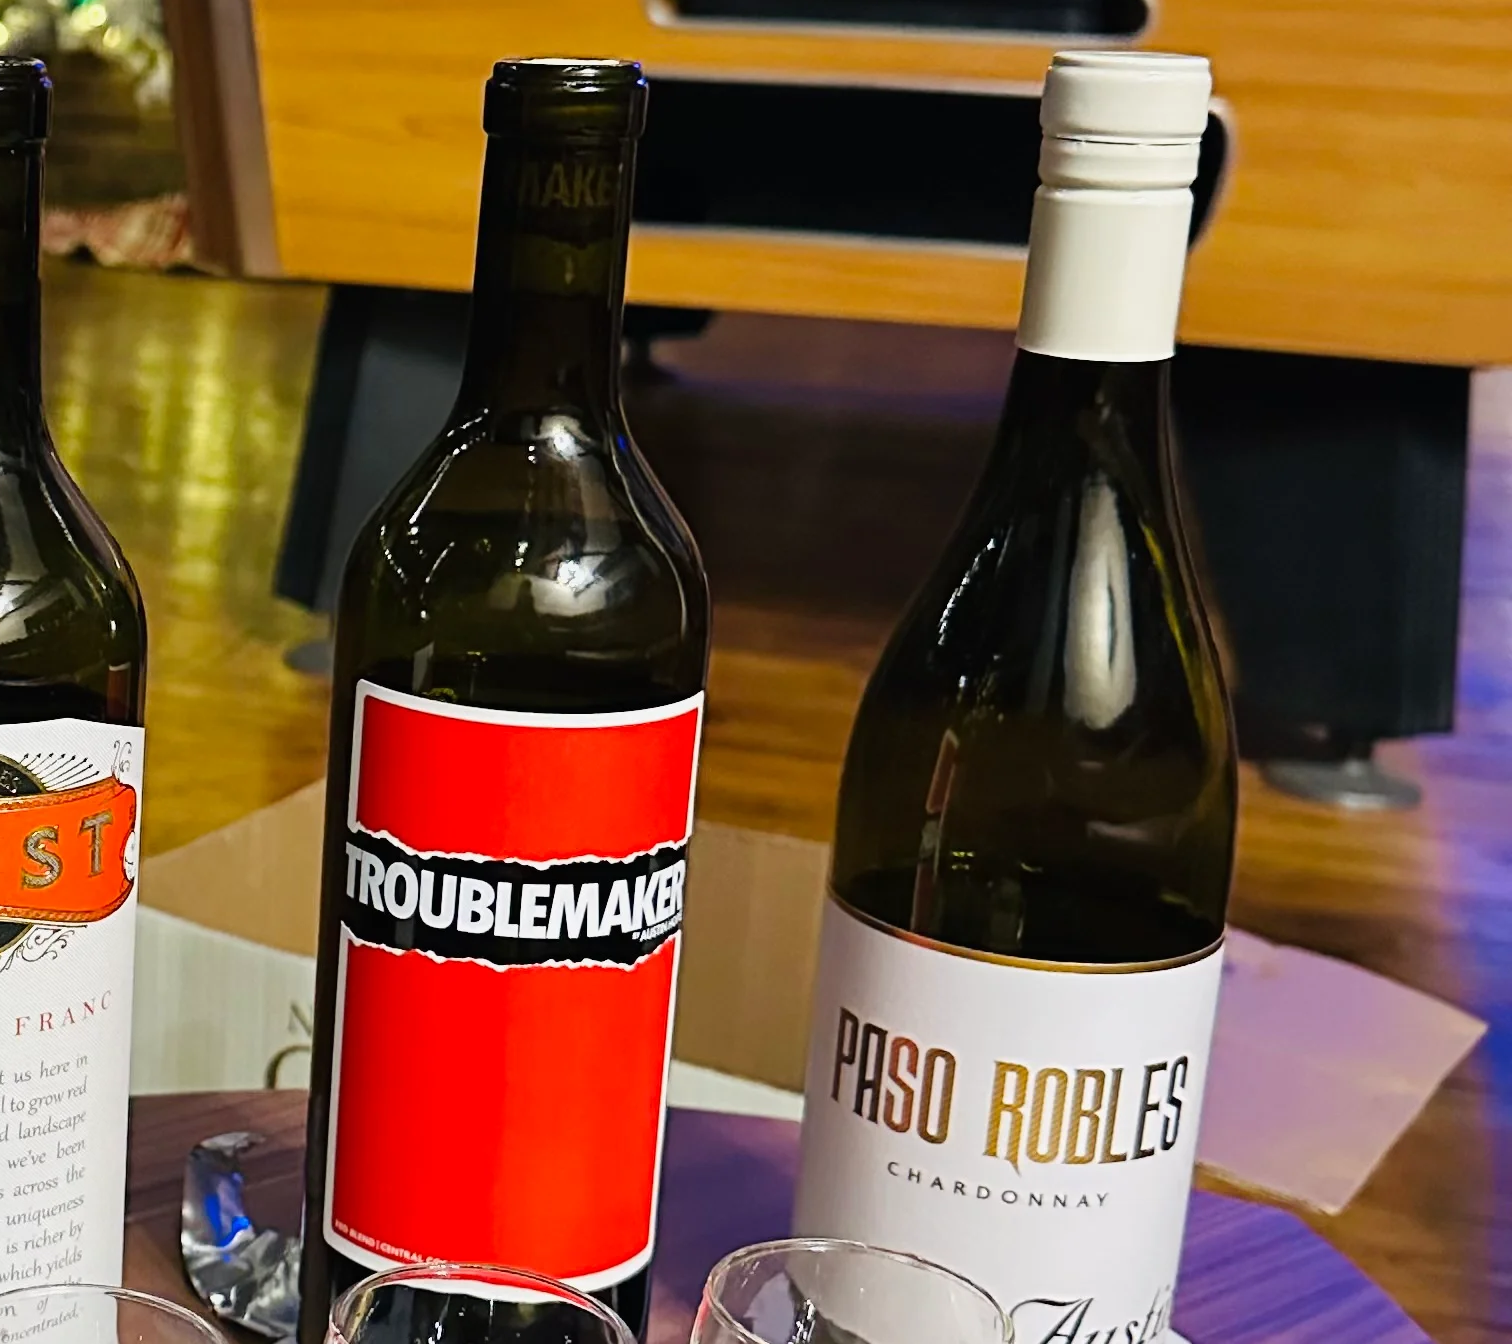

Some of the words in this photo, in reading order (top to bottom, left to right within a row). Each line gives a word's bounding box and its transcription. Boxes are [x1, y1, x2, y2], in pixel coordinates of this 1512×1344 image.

[345, 841, 686, 940] TROUBLEMAKER
[14, 990, 113, 1037] FRANC
[14, 1069, 32, 1083] us
[39, 1060, 70, 1080] here
[76, 1053, 89, 1068] in
[10, 1097, 26, 1112] to
[28, 1091, 64, 1115] grow
[67, 1076, 88, 1097] red
[829, 1006, 958, 1145] PASO
[982, 1055, 1190, 1177] ROBLES
[18, 1110, 87, 1141] landscape
[8, 1152, 47, 1169] we've
[56, 1138, 86, 1159] been
[13, 1177, 59, 1197] across
[66, 1165, 86, 1182] the
[887, 1161, 1110, 1208] CHARDONNAY
[5, 1195, 85, 1229] uniqueness
[6, 1238, 18, 1254] is
[24, 1229, 64, 1252] richer
[69, 1220, 85, 1243] by
[379, 1242, 424, 1264] CENTRAL
[45, 1248, 83, 1277] yields
